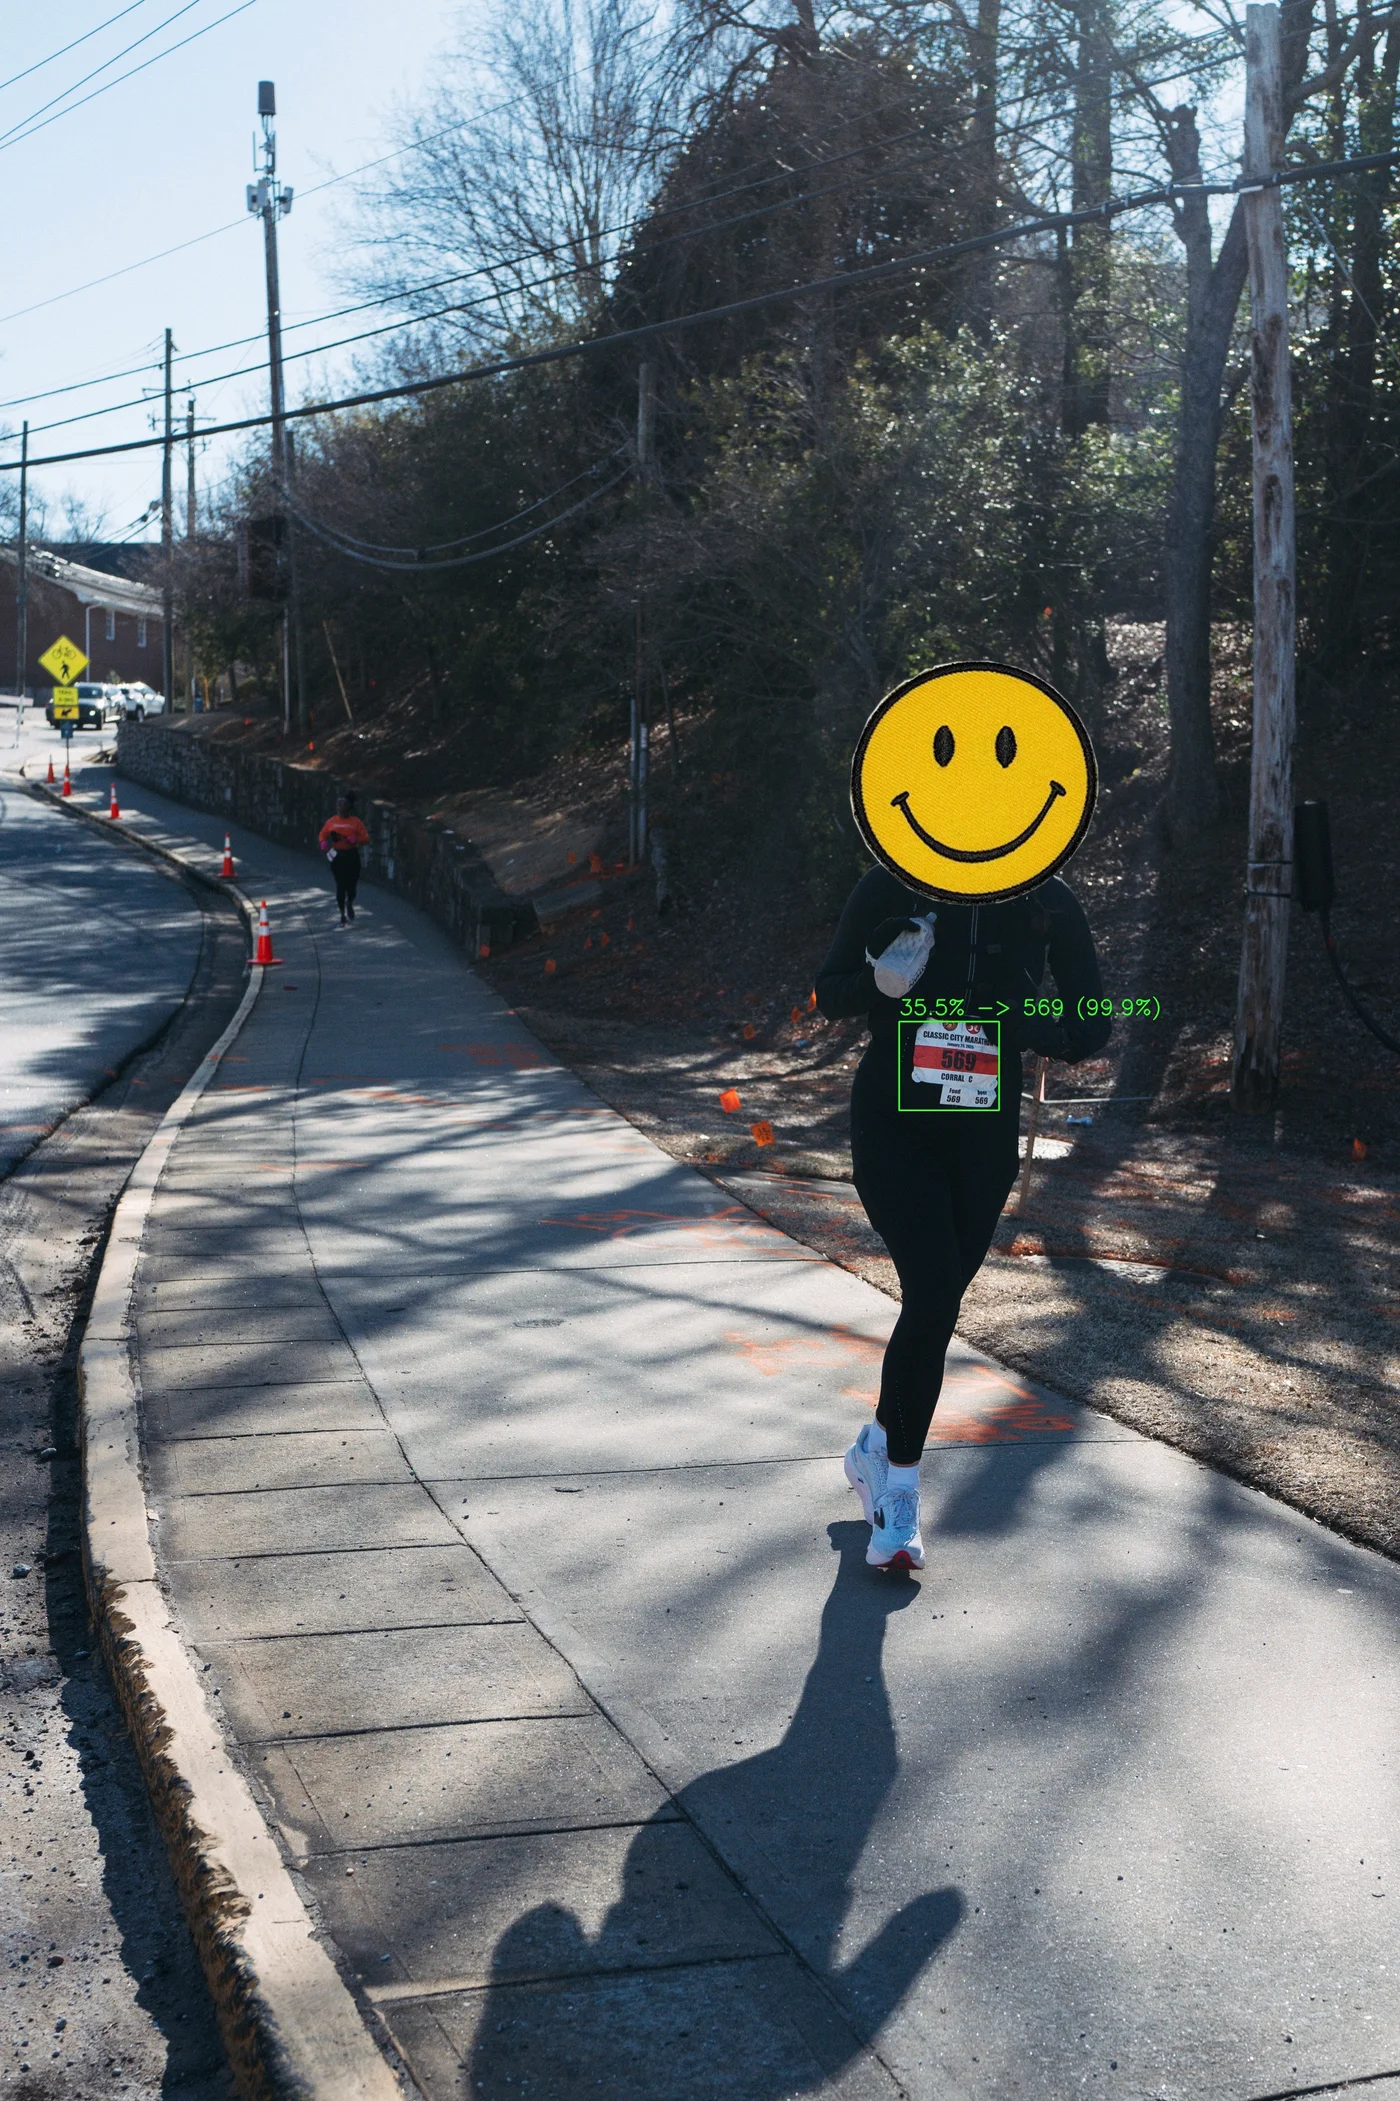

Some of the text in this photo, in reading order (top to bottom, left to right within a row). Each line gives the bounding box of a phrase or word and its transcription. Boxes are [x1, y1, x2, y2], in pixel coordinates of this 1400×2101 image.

[923, 1031, 949, 1040] CLASSIC
[950, 1033, 964, 1042] CITY
[941, 1050, 977, 1071] 569
[941, 1073, 973, 1083] CORRAL C
[946, 1095, 961, 1103] 569
[975, 1096, 989, 1105] 569
